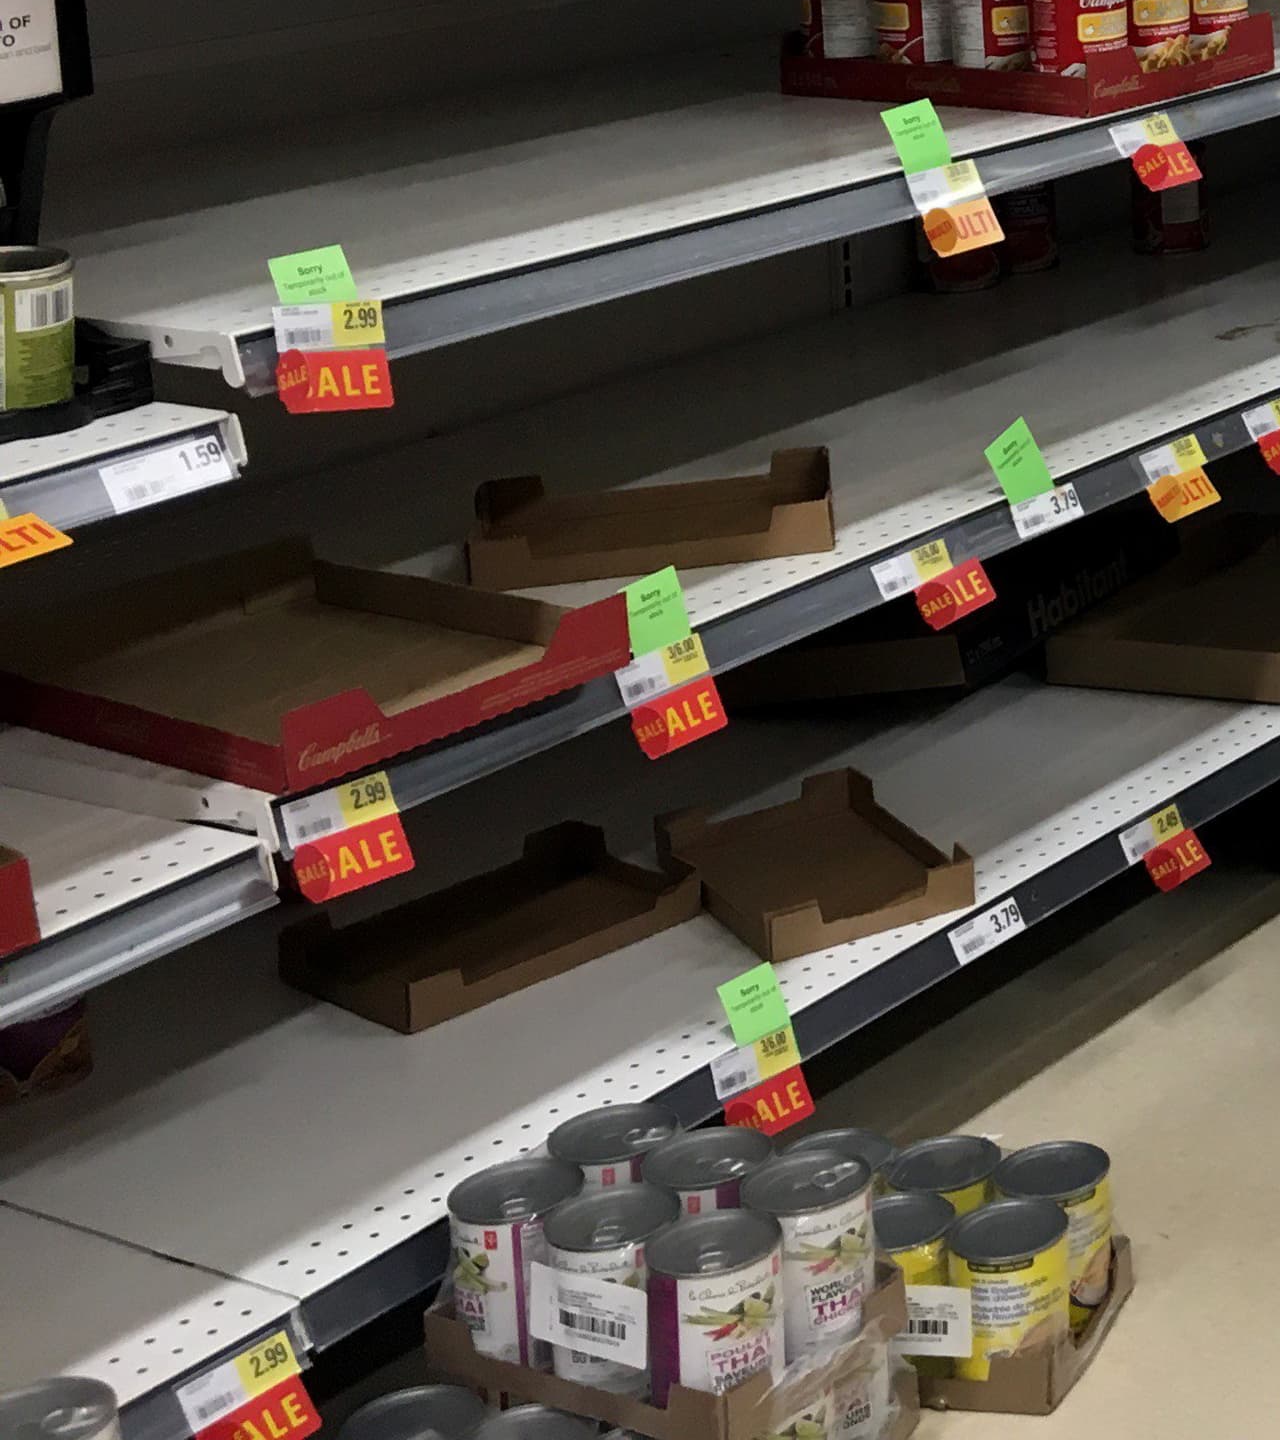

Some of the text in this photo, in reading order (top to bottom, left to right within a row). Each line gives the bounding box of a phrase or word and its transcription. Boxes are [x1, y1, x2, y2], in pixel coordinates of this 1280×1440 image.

[9, 15, 32, 31] OF
[1138, 154, 1166, 177] SALE
[958, 210, 998, 240] ULTI
[297, 264, 322, 277] Sorry
[343, 307, 377, 330] 2.99
[278, 364, 308, 391] SALE
[307, 363, 381, 398] ALE
[178, 440, 222, 472] 1.59
[1052, 488, 1079, 516] 3.79
[0, 521, 56, 554] LTI
[921, 593, 953, 618] SALE
[667, 637, 696, 661] 3/6.00
[667, 690, 717, 738] ALE
[636, 719, 666, 743] SALE
[350, 781, 387, 810] 2.99
[326, 830, 402, 883] ALE
[1152, 859, 1178, 880] SALE
[296, 862, 328, 886] SALE
[990, 903, 1020, 933] 3.79
[761, 1031, 787, 1054] 3/6.00
[756, 1080, 805, 1124] ALE
[250, 1341, 289, 1379] 2.99
[241, 1391, 309, 1440] ALE
